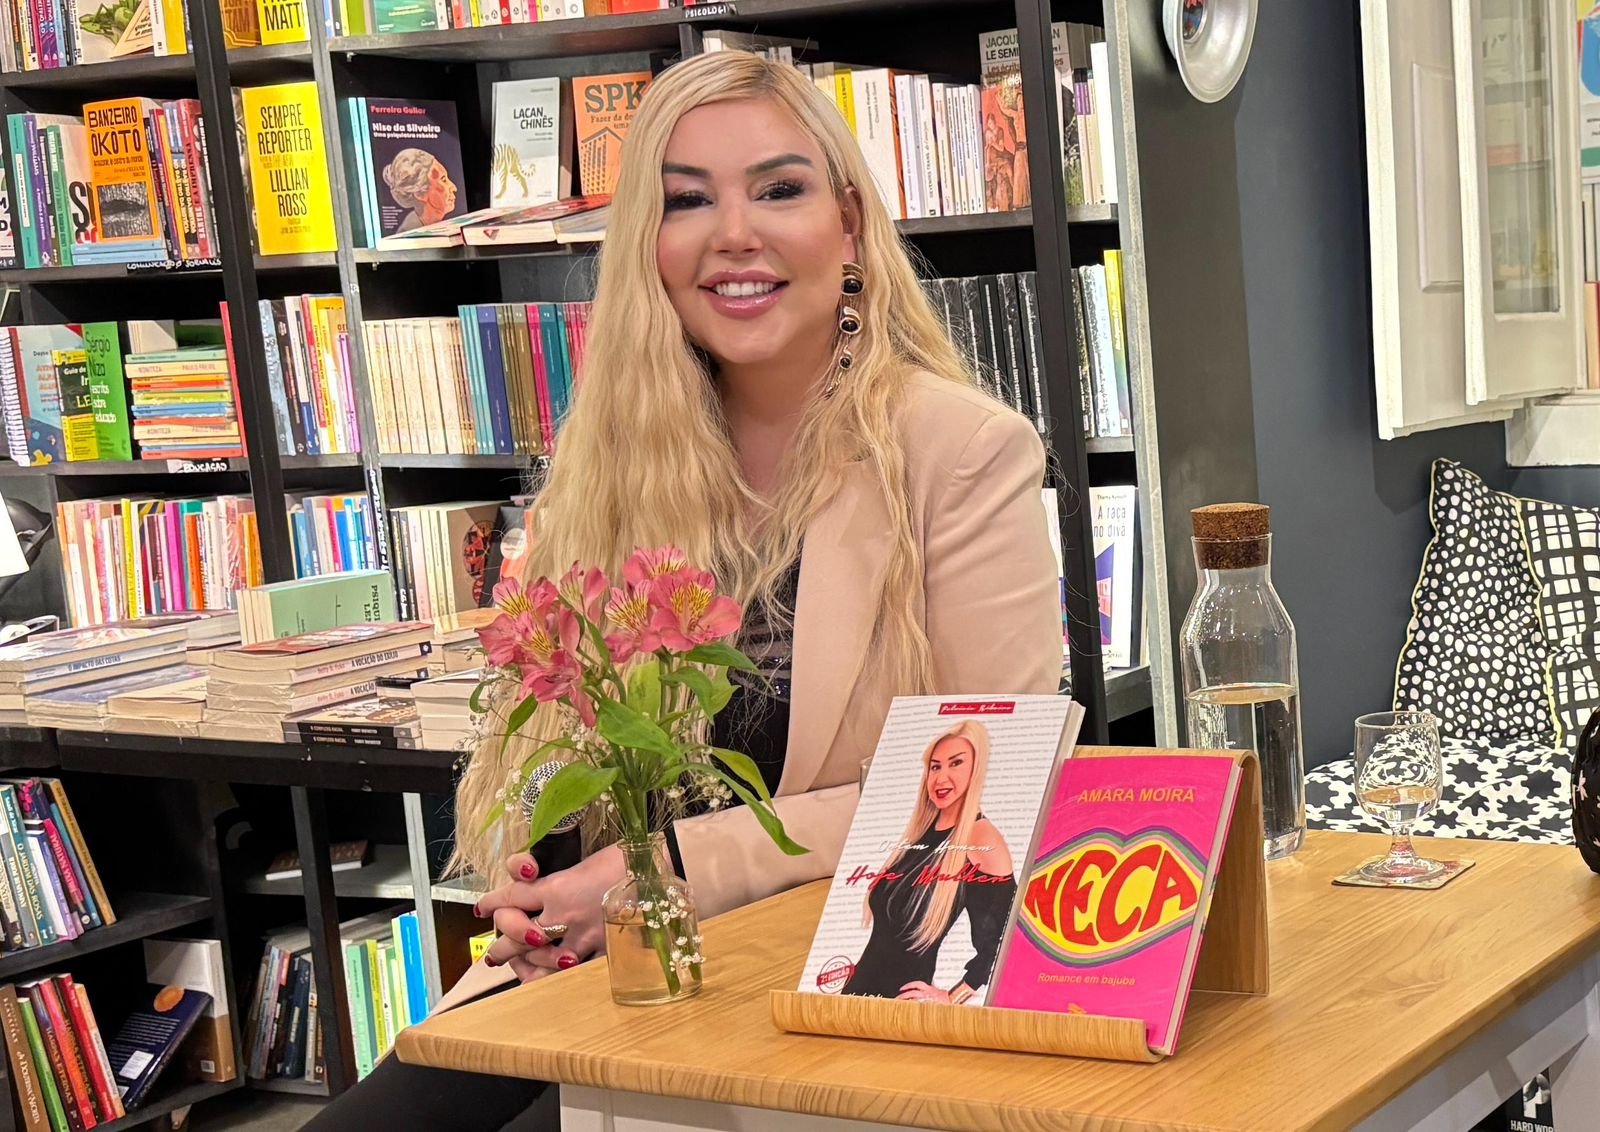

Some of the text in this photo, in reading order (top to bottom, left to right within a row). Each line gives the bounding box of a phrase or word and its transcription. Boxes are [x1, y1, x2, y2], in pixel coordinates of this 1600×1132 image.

[685, 5, 729, 18] PSICOLOGI
[986, 34, 1018, 48] JACQU
[986, 50, 997, 60] LE
[585, 80, 646, 113] SPK
[88, 105, 138, 129] BANZEIRO
[260, 104, 304, 129] SEMPRE
[513, 107, 543, 119] LACAN
[590, 115, 611, 124] Fazer
[613, 114, 622, 122] da
[393, 123, 405, 132] da
[406, 123, 441, 133] Silveira
[520, 114, 553, 130] CHINÊS
[91, 124, 141, 157] ÒKÒTÓ
[29, 144, 42, 175] WILLIAMS
[270, 168, 309, 192] LILLIAN
[278, 193, 307, 217] ROSS
[195, 206, 206, 238] SARTRE
[85, 331, 111, 357] Sérgio
[63, 367, 78, 376] Guia
[1098, 505, 1102, 520] A
[1093, 525, 1103, 537] no
[371, 584, 381, 622] PSIQUI
[73, 659, 94, 671] IMPACTO
[105, 655, 121, 665] COTAS
[351, 660, 356, 668] A
[356, 655, 377, 667] VOCAÇÃO
[377, 653, 384, 662] DO
[350, 681, 377, 695] A VOCAÇÃO
[1077, 787, 1195, 803] AMARA MOIRA
[934, 839, 994, 855] Homem
[16, 842, 44, 920] O JARDIM DAS ROSAS
[846, 863, 1012, 891] Hoje Mulher
[1024, 844, 1198, 946] NECA
[1038, 973, 1081, 984] Romance
[1083, 975, 1099, 984] em
[1534, 1123, 1554, 1132] WOR
